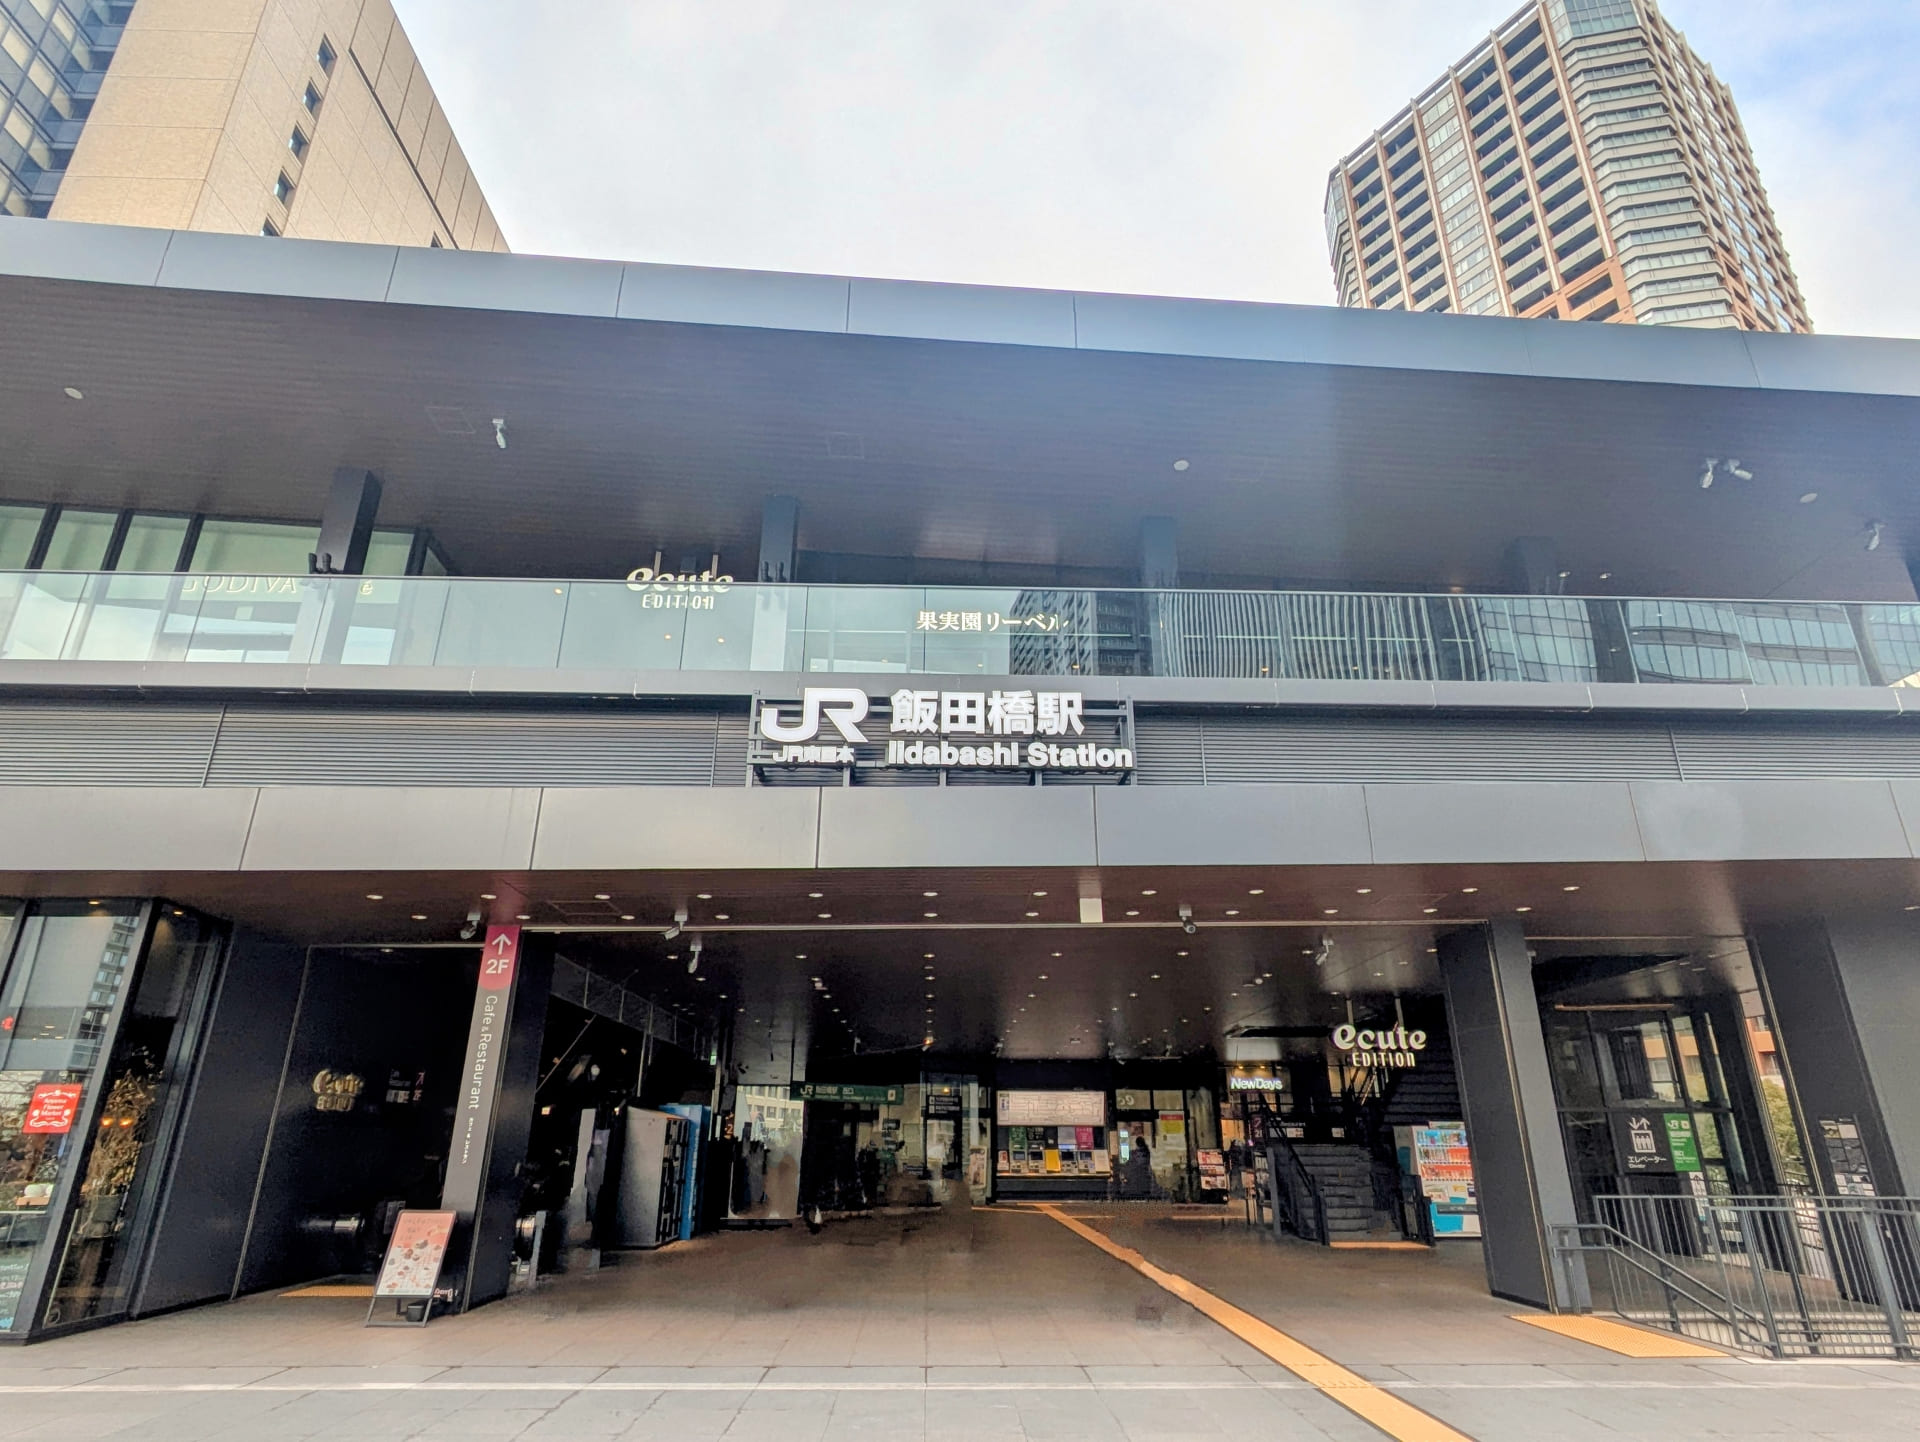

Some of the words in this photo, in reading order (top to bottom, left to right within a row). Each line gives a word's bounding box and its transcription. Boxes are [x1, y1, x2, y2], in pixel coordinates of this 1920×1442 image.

[626, 567, 734, 593] ecute
[642, 593, 715, 610] EDITION
[760, 687, 869, 743] JR
[890, 689, 1085, 735] 飯田橋駅
[1027, 742, 1133, 769] Station
[485, 958, 510, 975] 2F
[1333, 1024, 1427, 1050] ecute
[1352, 1052, 1416, 1067] EDITION
[1230, 1077, 1283, 1091] NewDays
